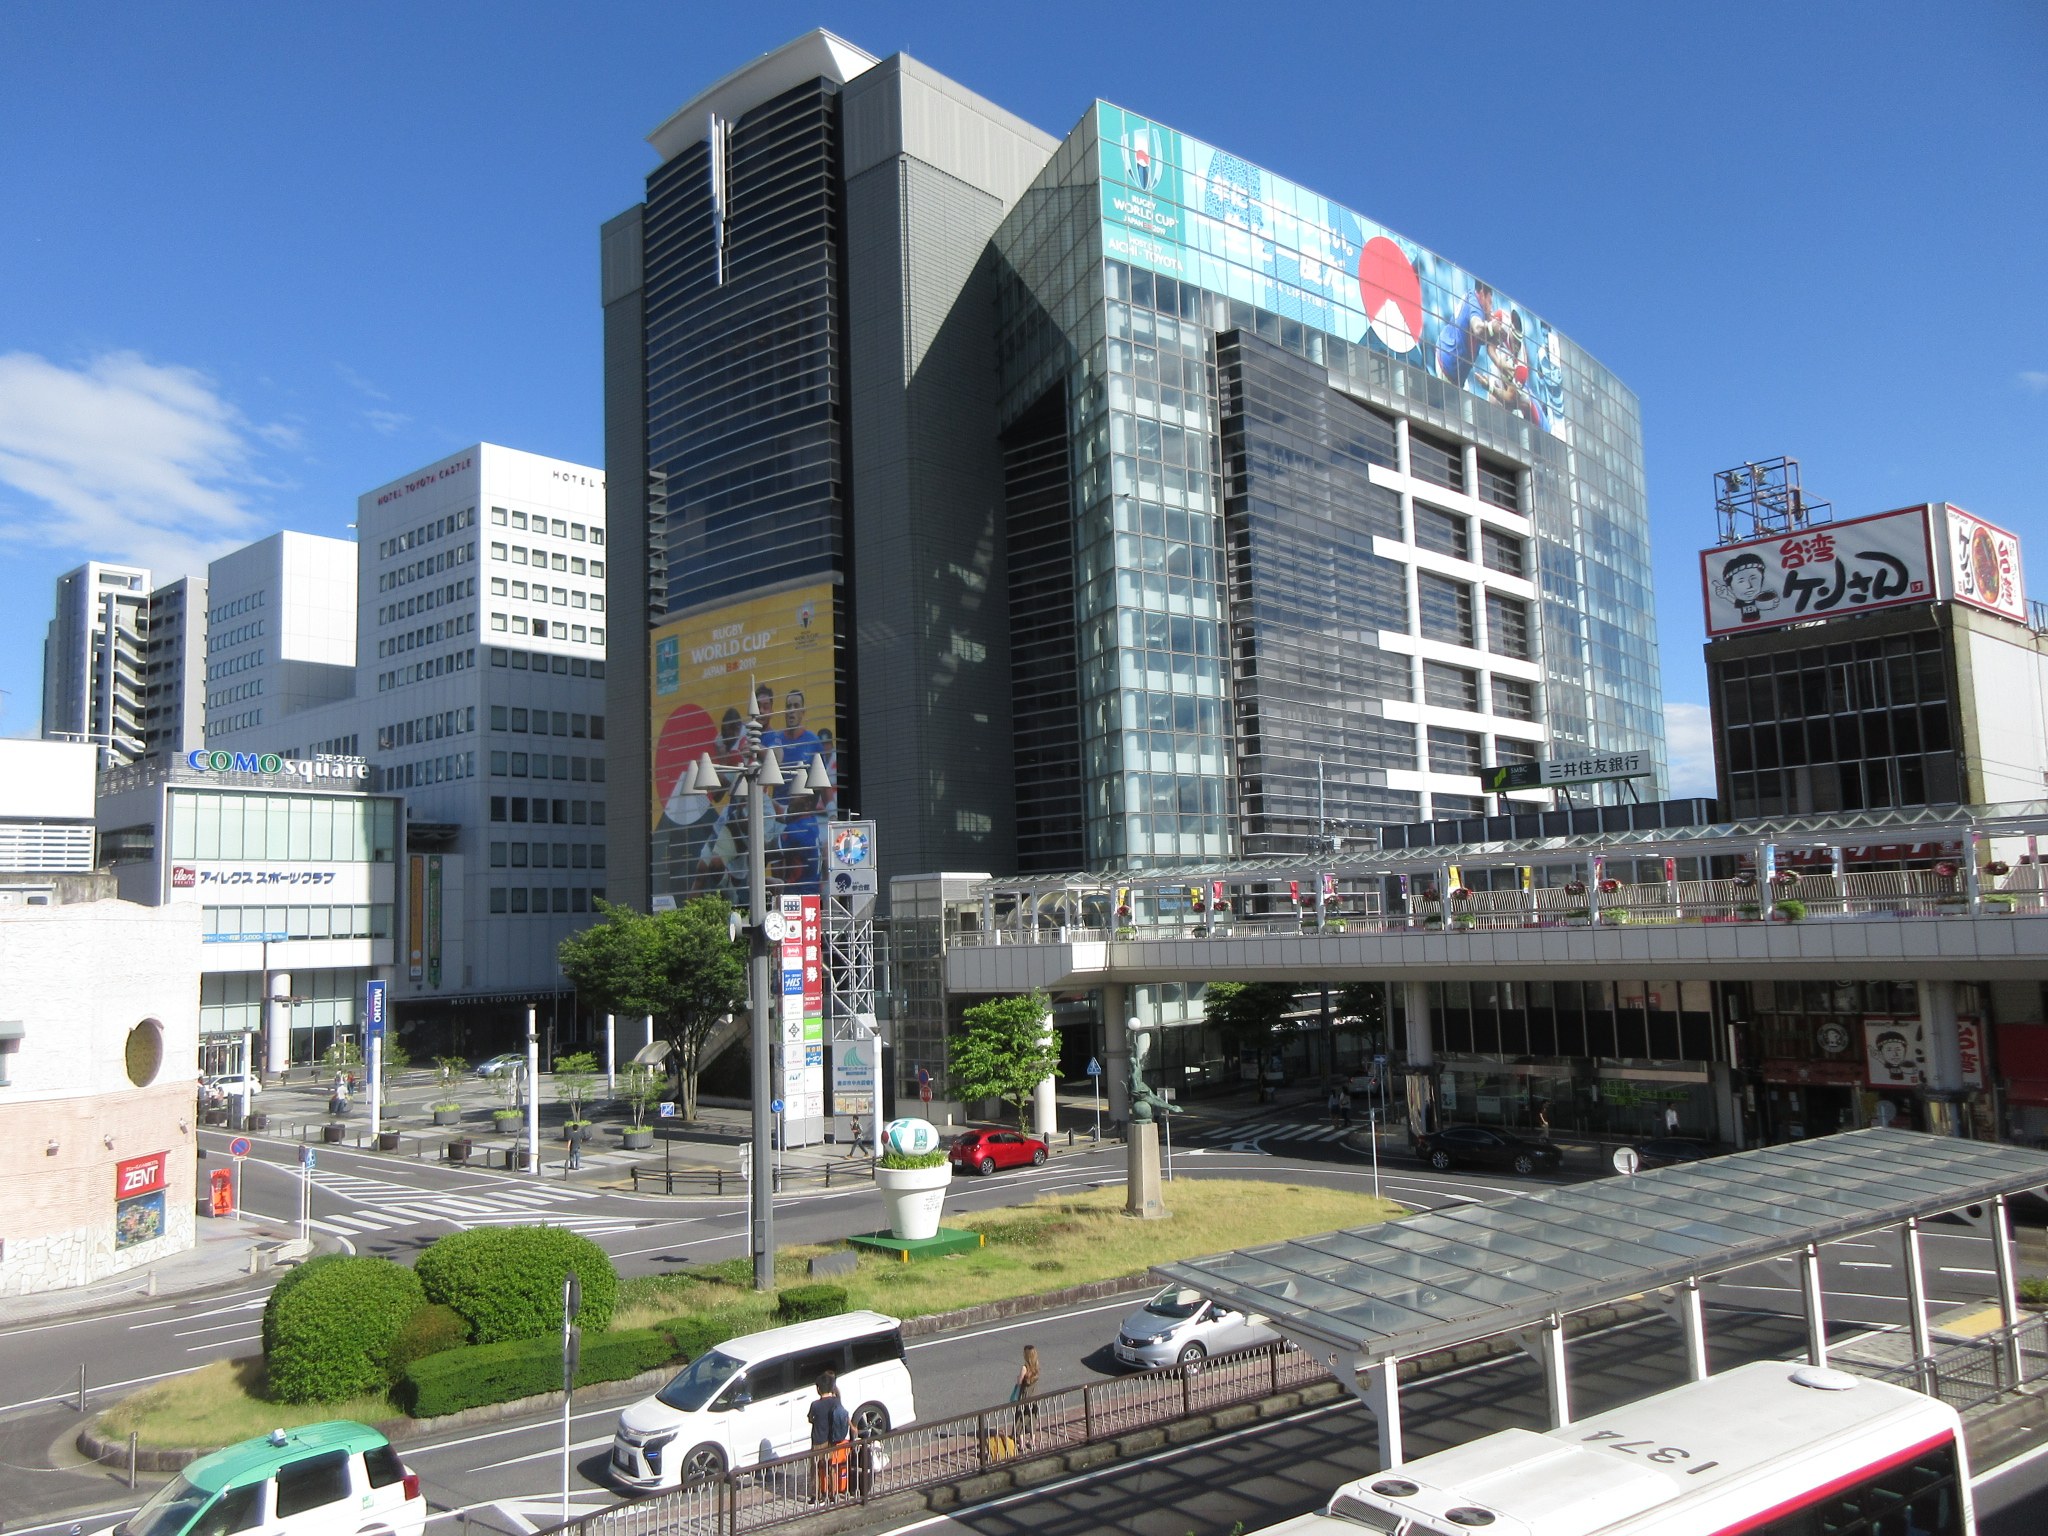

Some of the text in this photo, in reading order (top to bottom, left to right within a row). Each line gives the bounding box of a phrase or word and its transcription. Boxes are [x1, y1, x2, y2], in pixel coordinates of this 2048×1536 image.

[1113, 197, 1176, 227] WORLD CUP
[1132, 195, 1157, 210] RUGBY
[1123, 217, 1144, 228] JAPAN
[1152, 227, 1166, 236] 2019
[1109, 238, 1184, 272] AICHI TOYOTA
[1130, 235, 1163, 253] HOST CITY
[378, 458, 472, 506] HOTEL TOYOTA CASTLE
[552, 470, 595, 488] HOTEL
[1779, 533, 1836, 569] 台湾
[1783, 551, 1909, 613] ケンさん
[712, 622, 745, 641] RUGBY
[691, 639, 741, 665] WORLD
[742, 633, 771, 653] CUP
[702, 665, 727, 679] JAPAN
[739, 657, 757, 671] 2019
[188, 748, 371, 784] COMO square
[1510, 765, 1528, 775] SMBC
[1549, 755, 1640, 779] 三井住友銀行
[174, 868, 195, 881] ilex
[200, 871, 336, 885] アイレクス スポーツクラブ
[804, 906, 818, 983] 野村證券
[373, 988, 383, 1023] MIZUHO
[124, 1164, 159, 1192] ZENT
[1581, 1430, 1719, 1475] 1374
